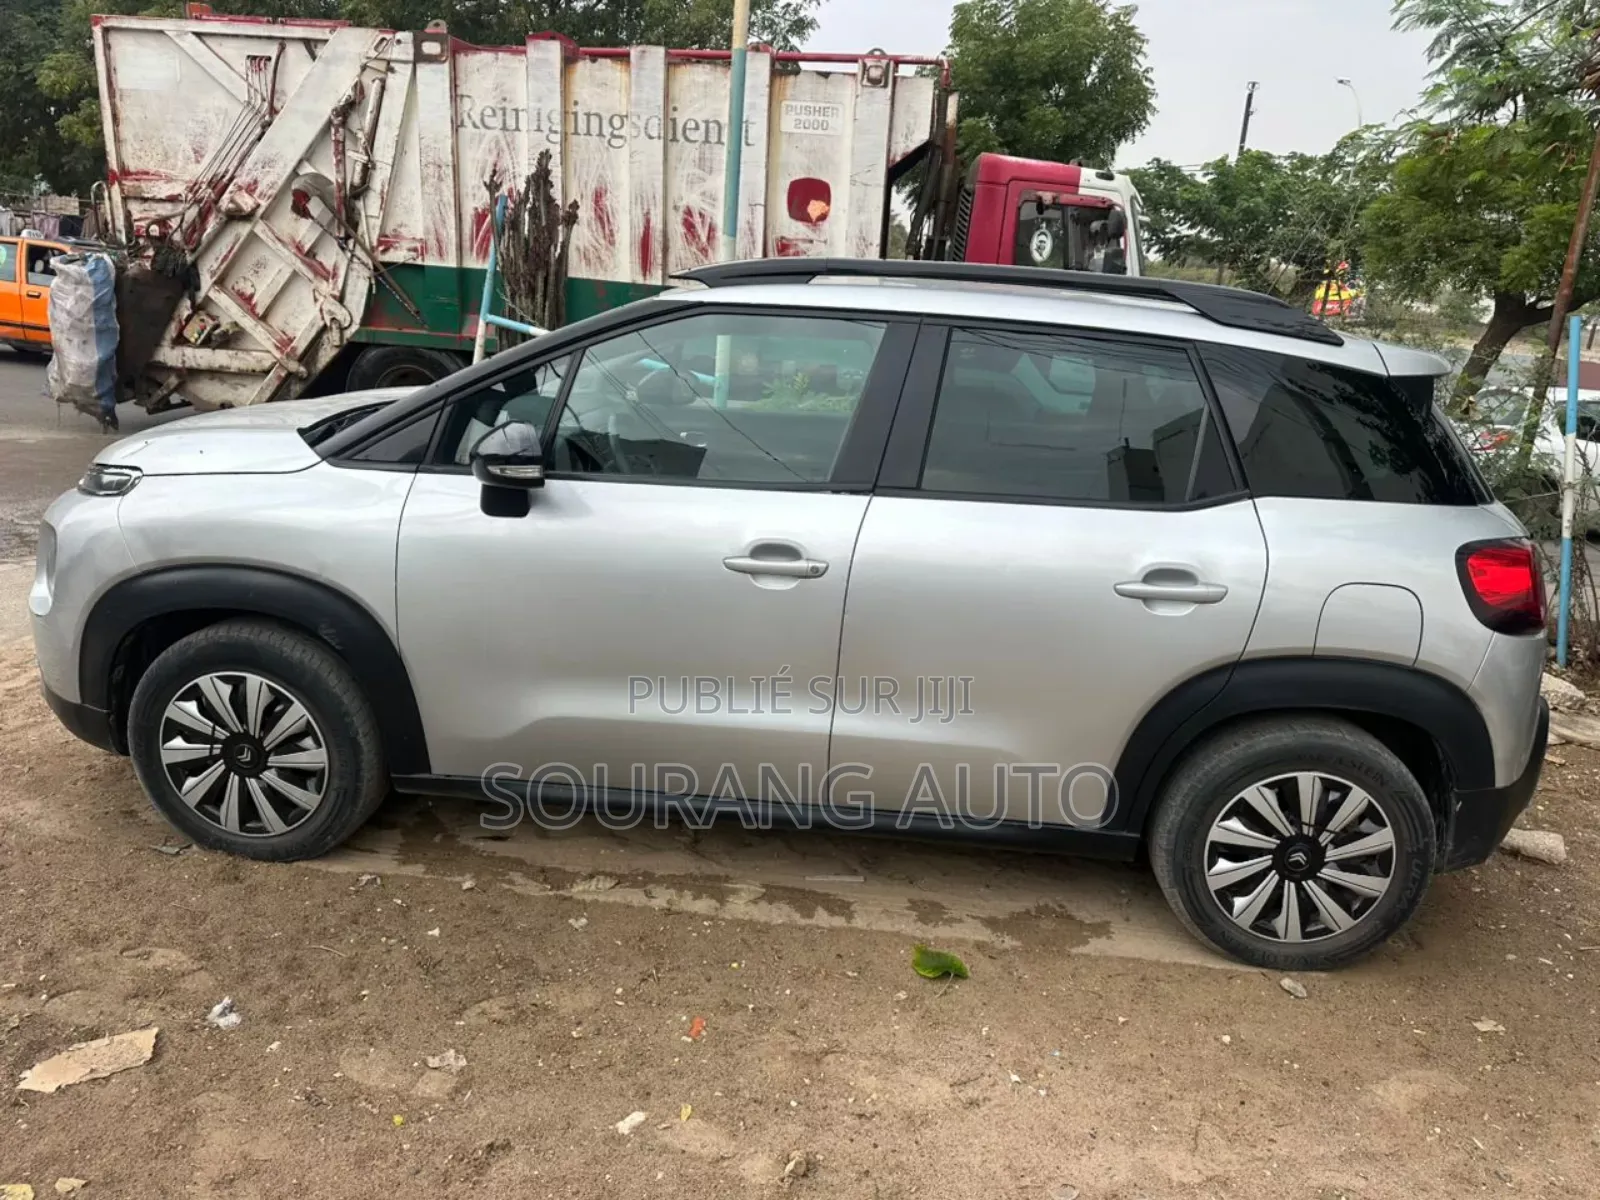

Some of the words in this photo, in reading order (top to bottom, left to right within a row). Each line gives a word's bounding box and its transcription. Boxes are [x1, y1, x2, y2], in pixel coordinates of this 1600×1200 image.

[784, 103, 840, 118] PUSHER
[456, 93, 757, 149] Reinigingsdient
[794, 118, 829, 131] 2000
